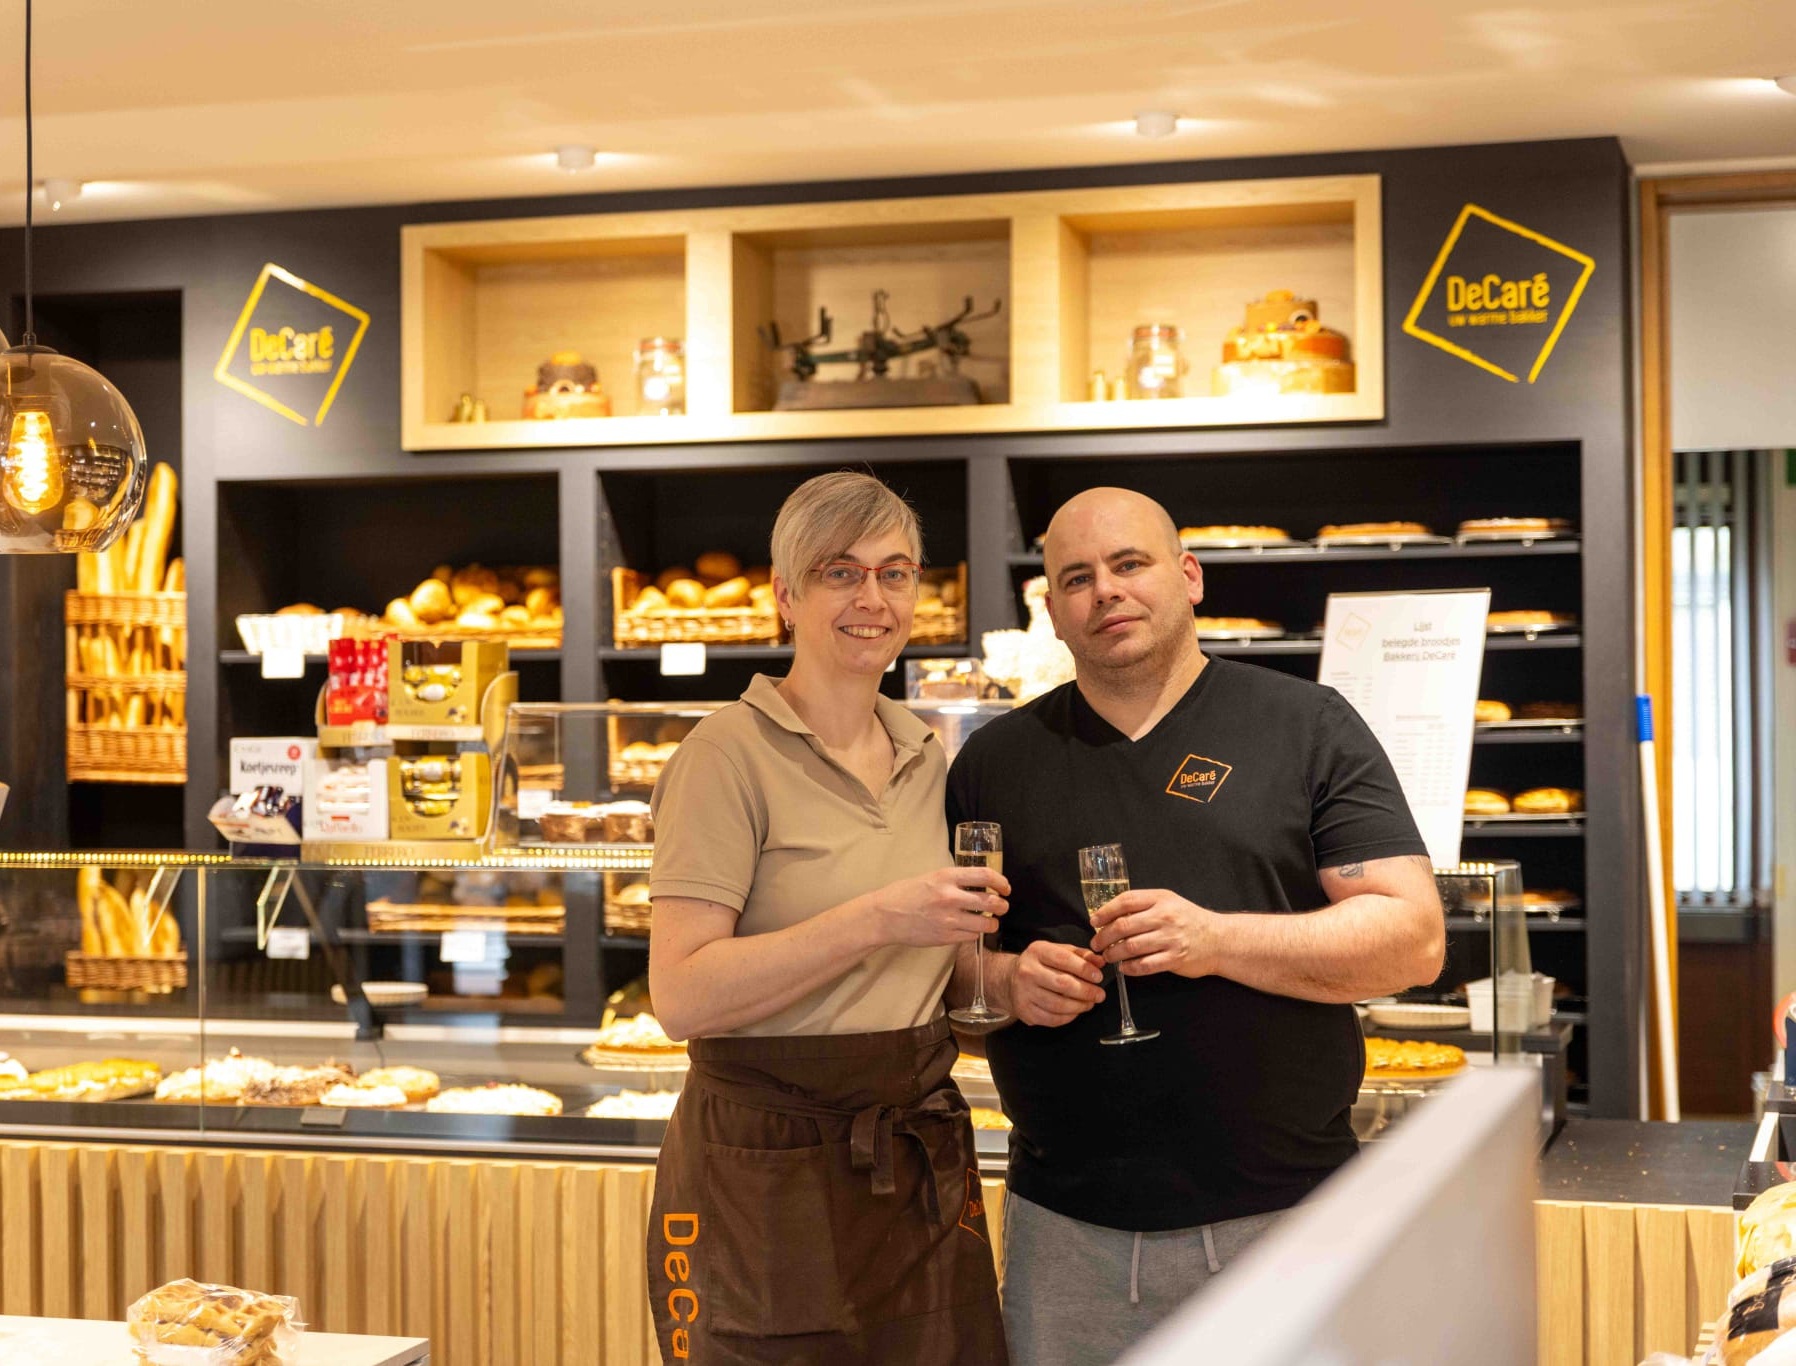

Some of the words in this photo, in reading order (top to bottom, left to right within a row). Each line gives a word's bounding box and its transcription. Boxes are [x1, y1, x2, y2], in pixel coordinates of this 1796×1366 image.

[1447, 273, 1550, 311] DeCaré
[249, 326, 334, 361] DeCaré
[1181, 771, 1216, 784] DeCaré
[663, 1212, 700, 1360] DeCa
